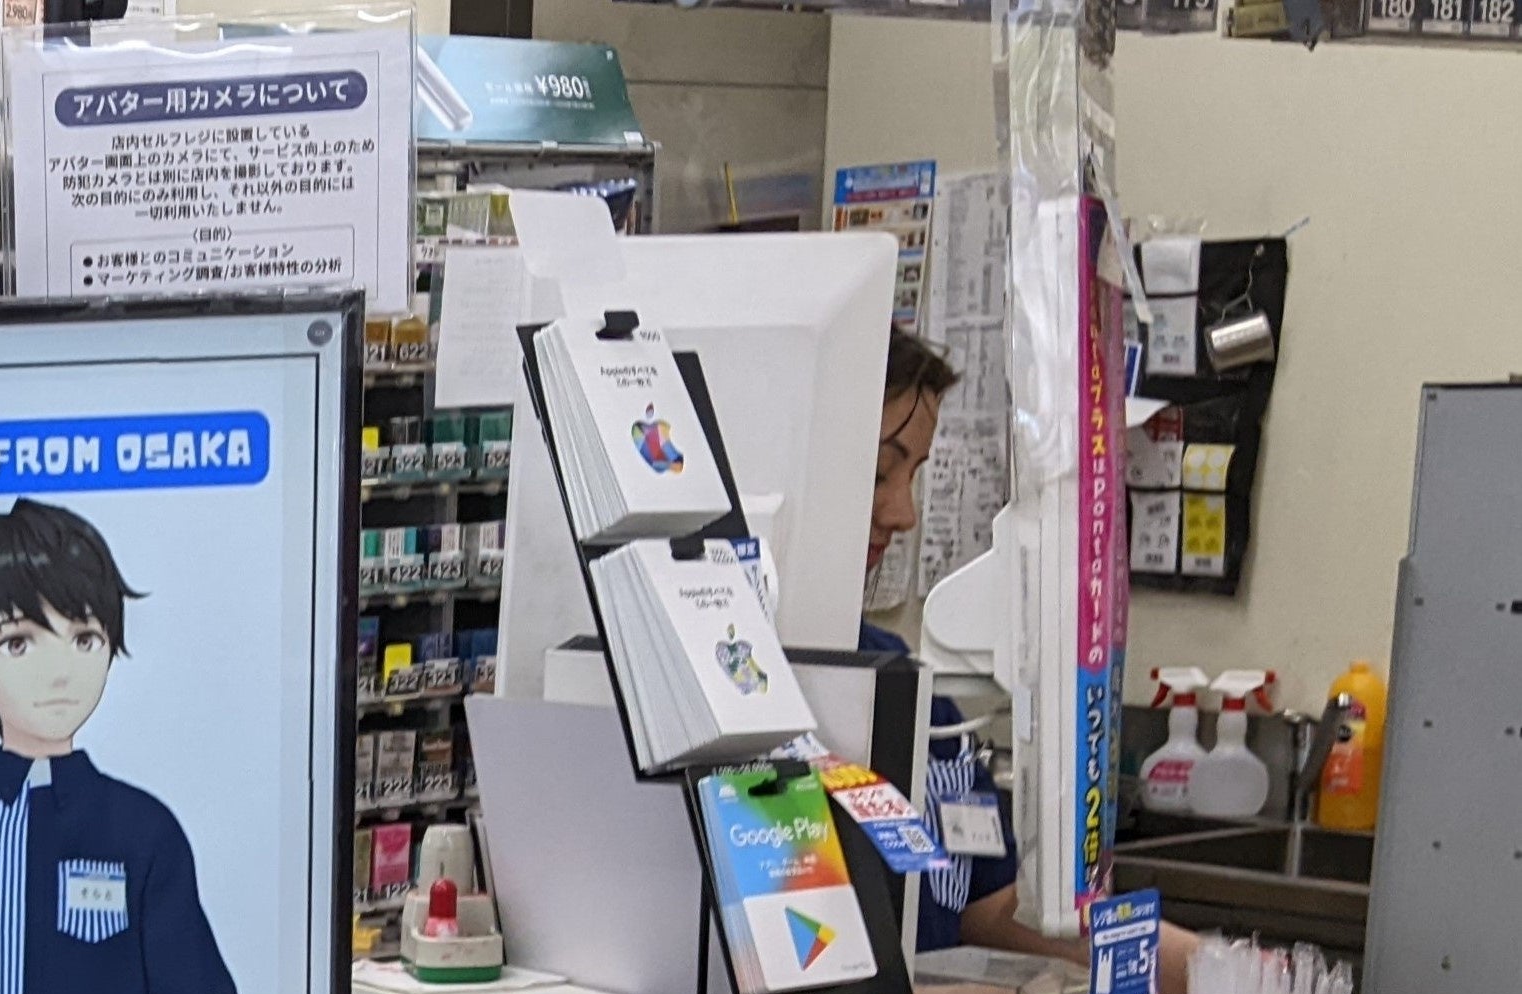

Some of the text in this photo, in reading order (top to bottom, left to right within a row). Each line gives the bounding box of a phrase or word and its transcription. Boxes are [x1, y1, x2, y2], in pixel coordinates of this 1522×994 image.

[72, 78, 350, 118] アバター用カメラについて
[111, 123, 311, 152] 店内セルフレジに設置している
[63, 160, 355, 190] 防犯カメラとは別に店内を撮影しております。
[72, 177, 355, 207] 次の目的にのみ利用し、それ以外の目的には
[135, 201, 284, 221] 一切利用いたしません。
[98, 243, 294, 269] お客様とのコミュニケーション
[116, 428, 252, 470] OSAKA
[729, 816, 828, 849] Google Play
